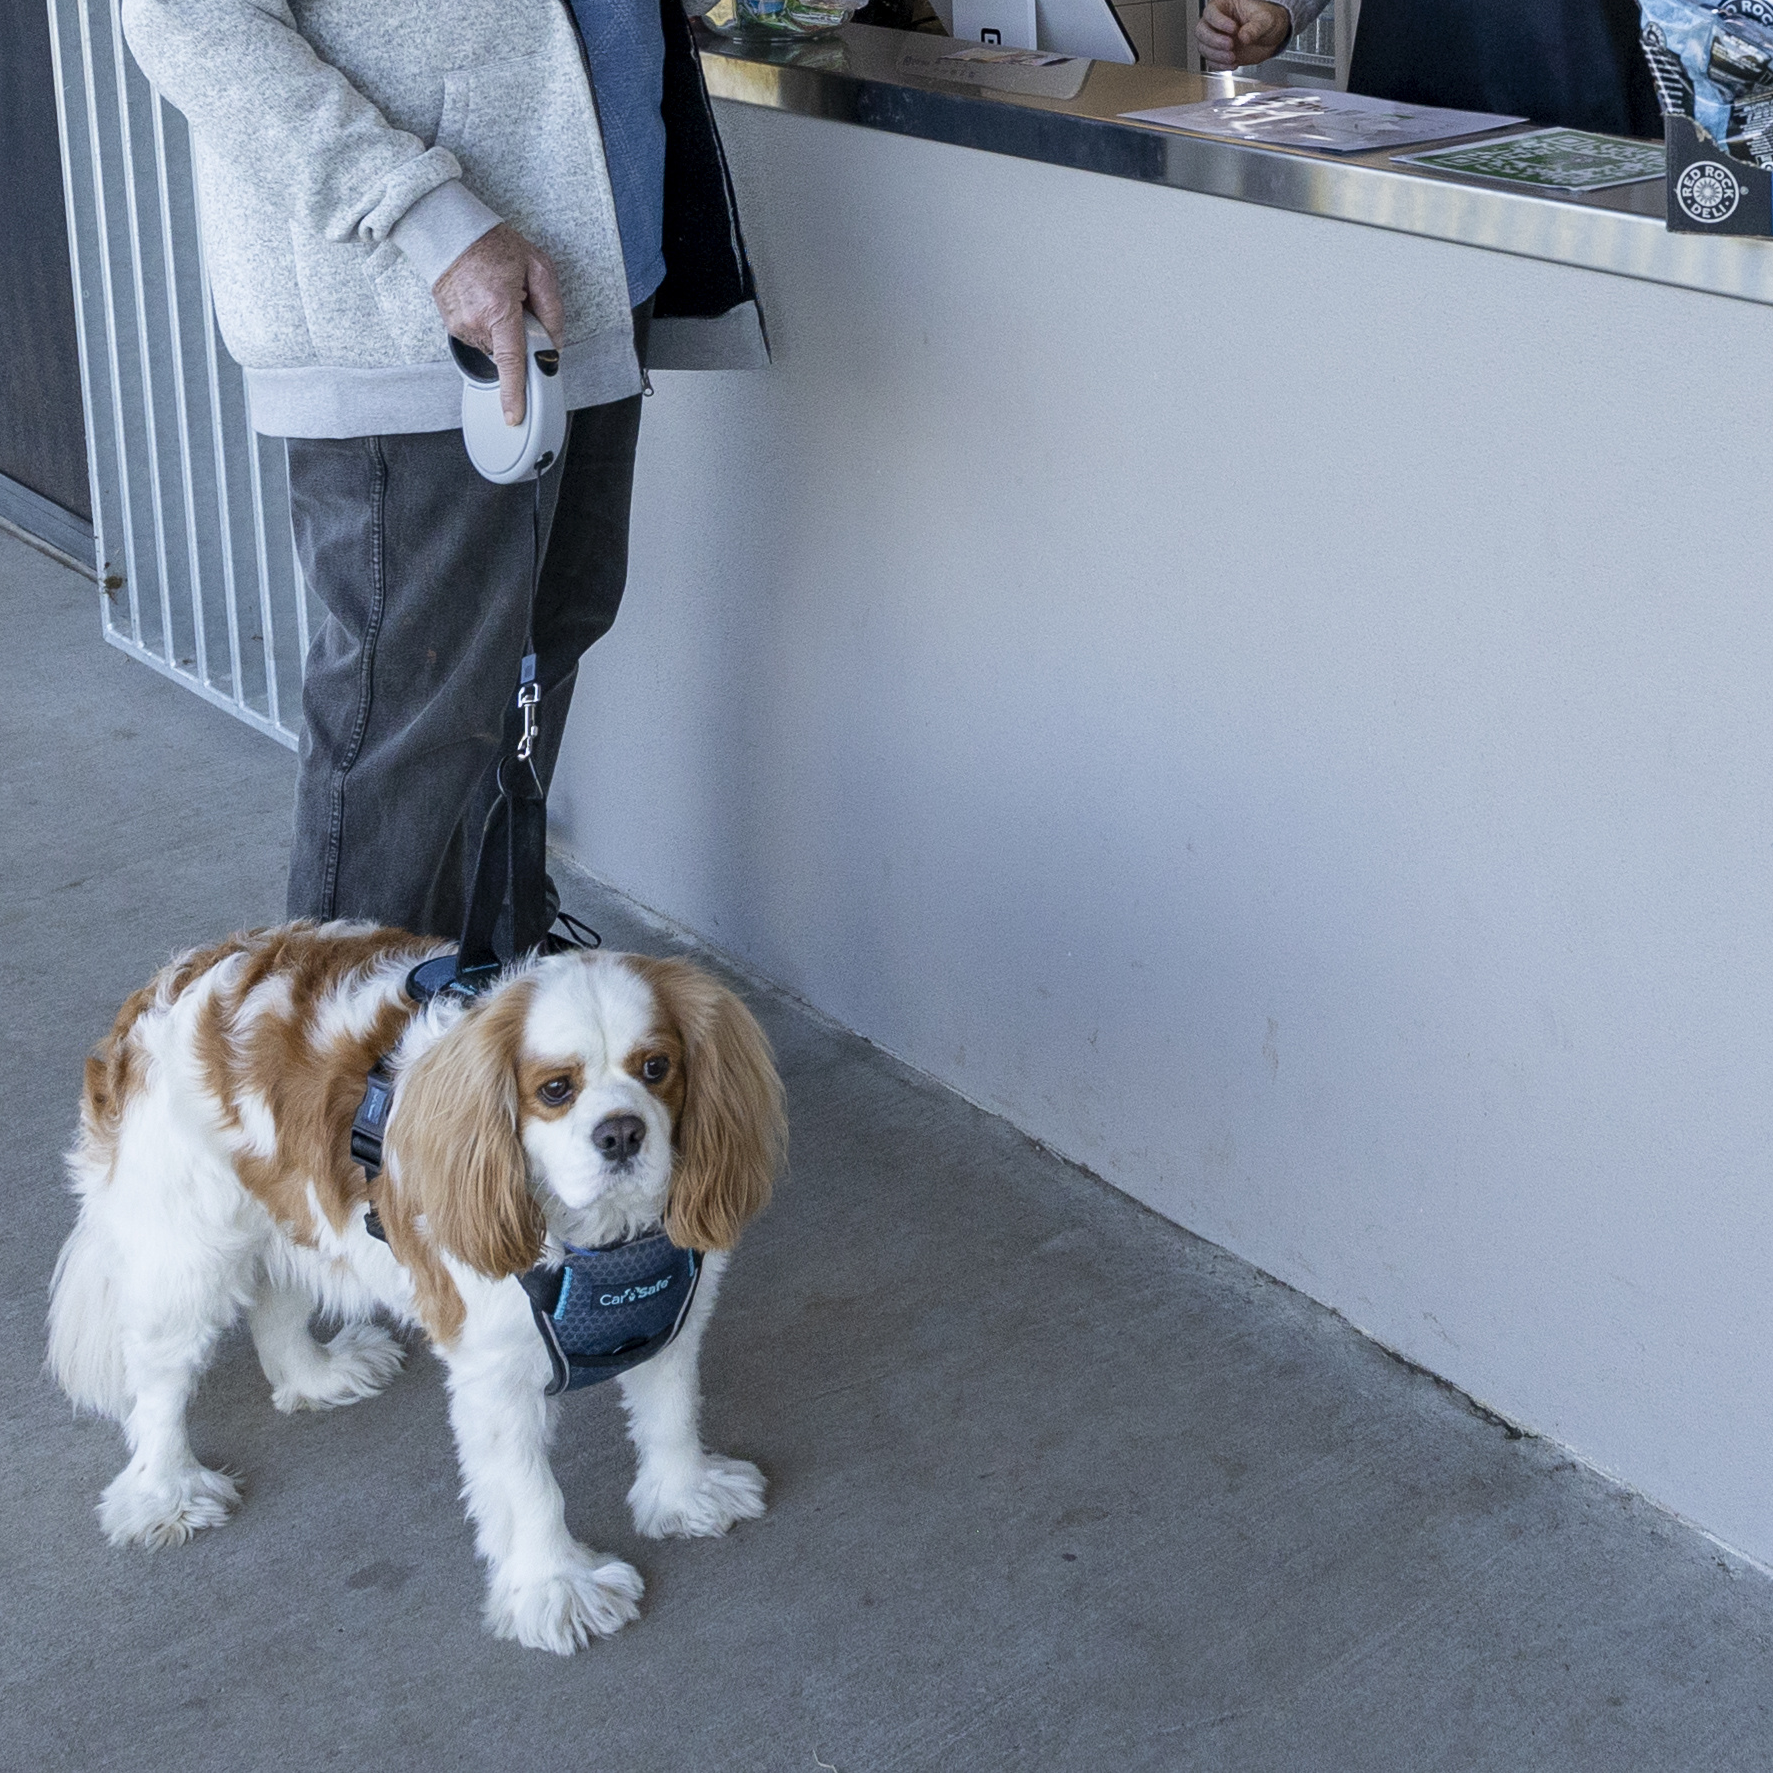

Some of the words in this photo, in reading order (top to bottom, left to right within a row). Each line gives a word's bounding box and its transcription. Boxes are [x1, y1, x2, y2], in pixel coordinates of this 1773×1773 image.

[1740, 0, 1773, 26] ROC
[1682, 169, 1701, 197] RED
[1705, 166, 1734, 198] ROCK
[1690, 203, 1727, 218] DELI
